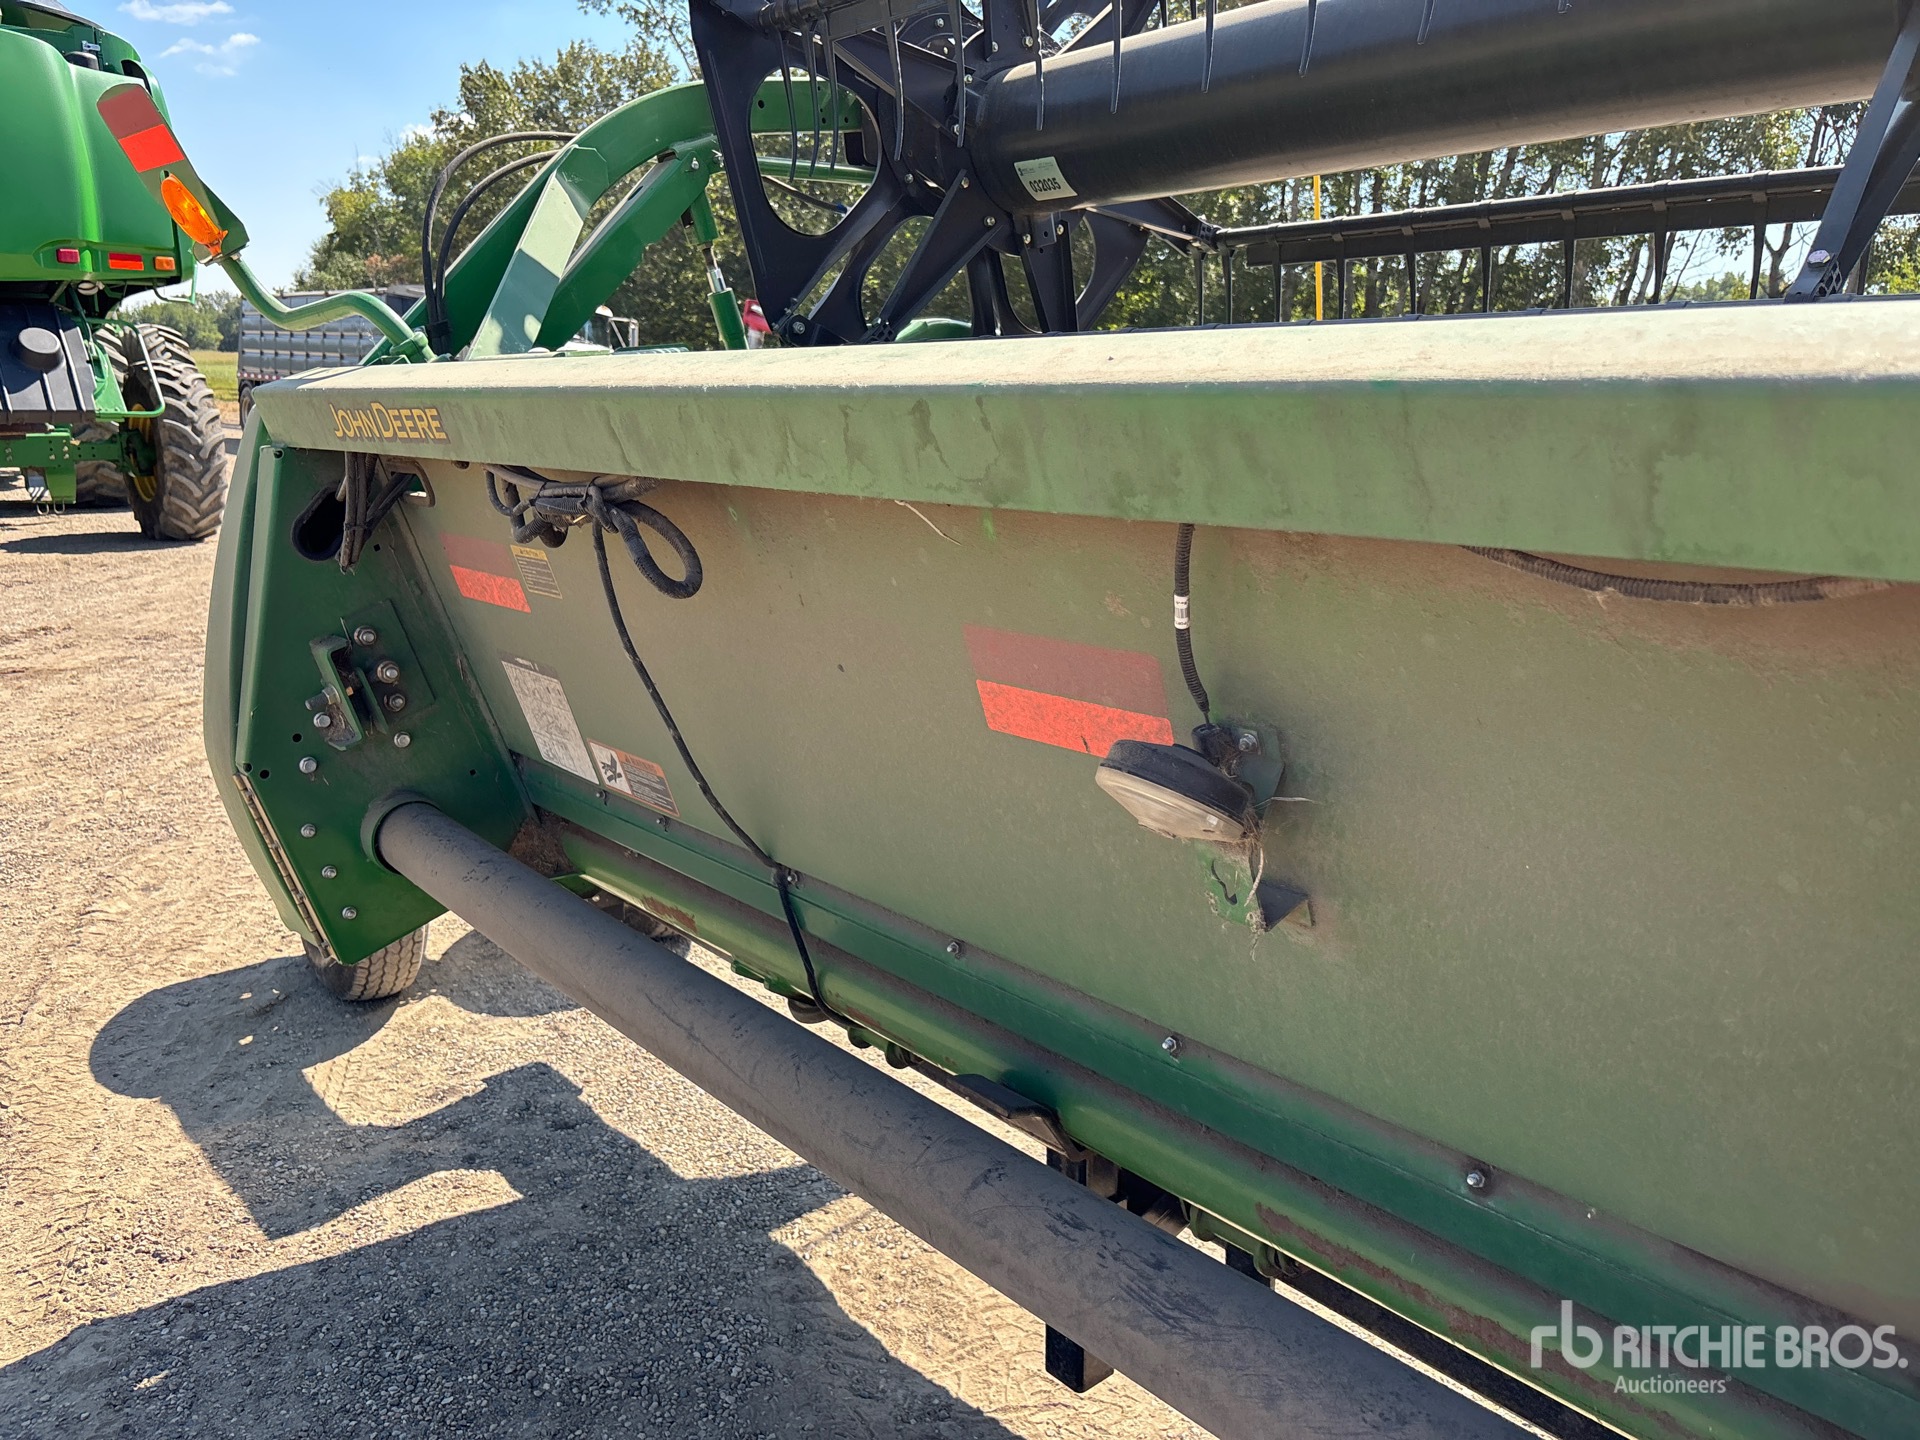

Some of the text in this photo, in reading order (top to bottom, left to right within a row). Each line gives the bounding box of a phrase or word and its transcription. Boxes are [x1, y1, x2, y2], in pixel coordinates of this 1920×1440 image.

[1028, 178, 1061, 193] 032035
[329, 402, 448, 440] JOHN DEERE
